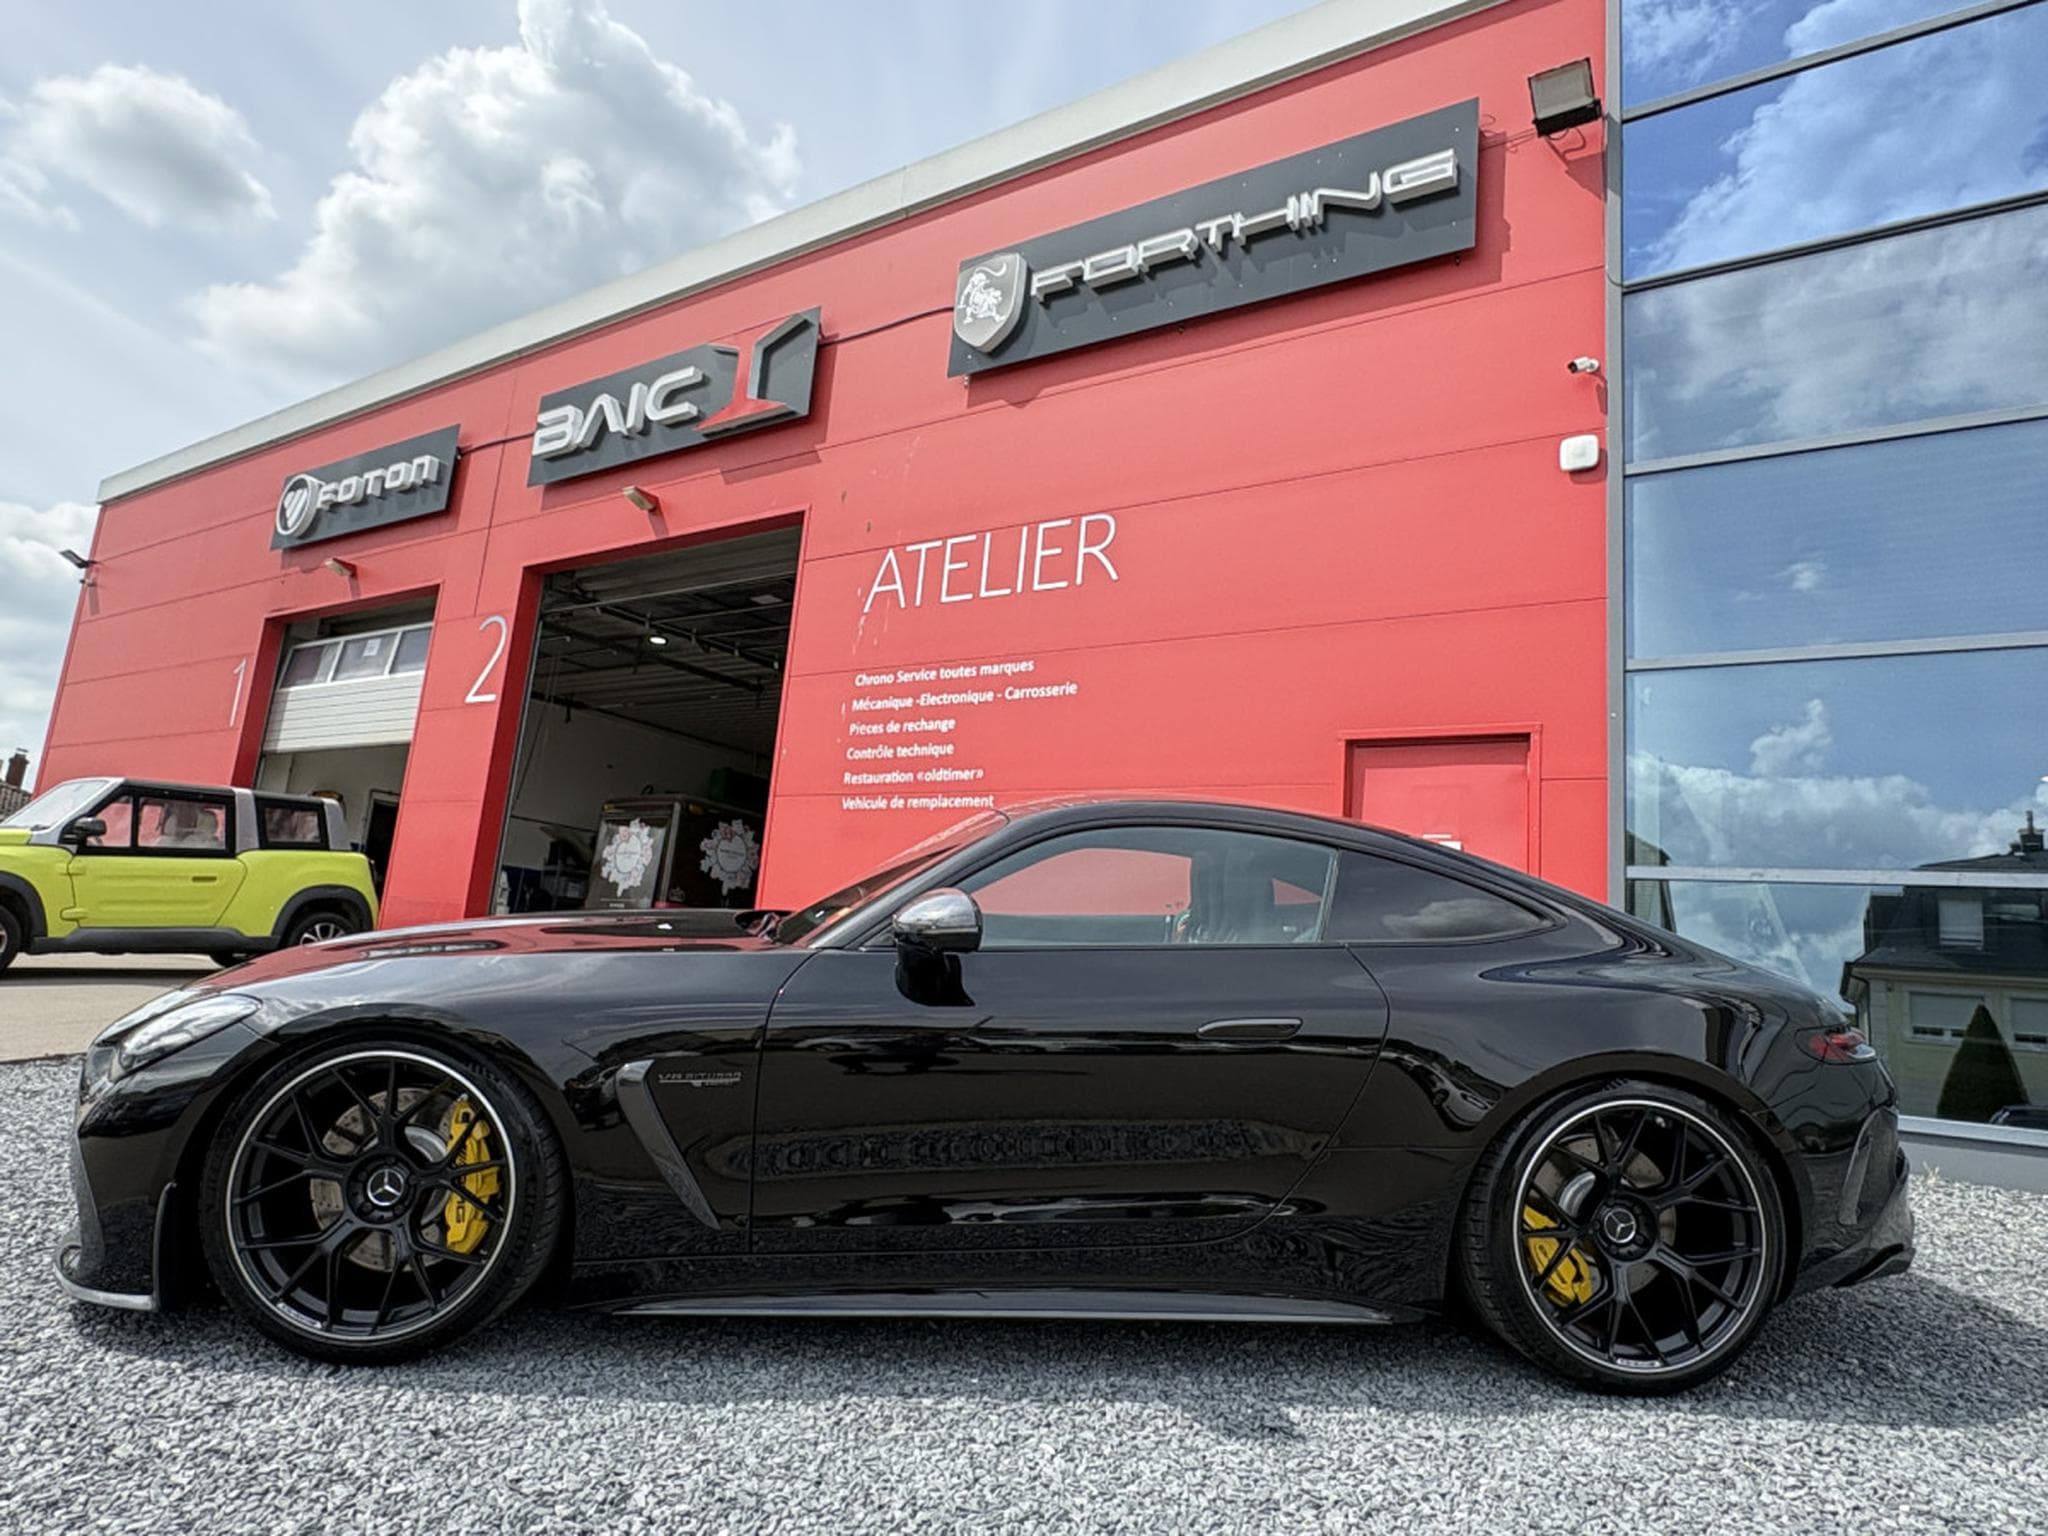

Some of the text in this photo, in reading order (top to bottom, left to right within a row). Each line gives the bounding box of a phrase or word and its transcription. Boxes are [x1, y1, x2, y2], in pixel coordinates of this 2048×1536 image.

[1031, 147, 1459, 301] FORTHING
[531, 365, 705, 460] BAIC
[863, 512, 1119, 613] ATELIER
[465, 614, 508, 704] 2
[855, 660, 1034, 687] Chrono Service toutes marques
[230, 658, 248, 728] 1
[852, 696, 914, 713] Mécanique
[1005, 681, 1078, 701] Carrosserie
[886, 720, 901, 733] de
[903, 716, 956, 733] rechange
[846, 742, 954, 760] Contrôle technique
[843, 771, 914, 785] Restauration
[890, 795, 905, 809] de
[907, 793, 994, 810] remplacement
